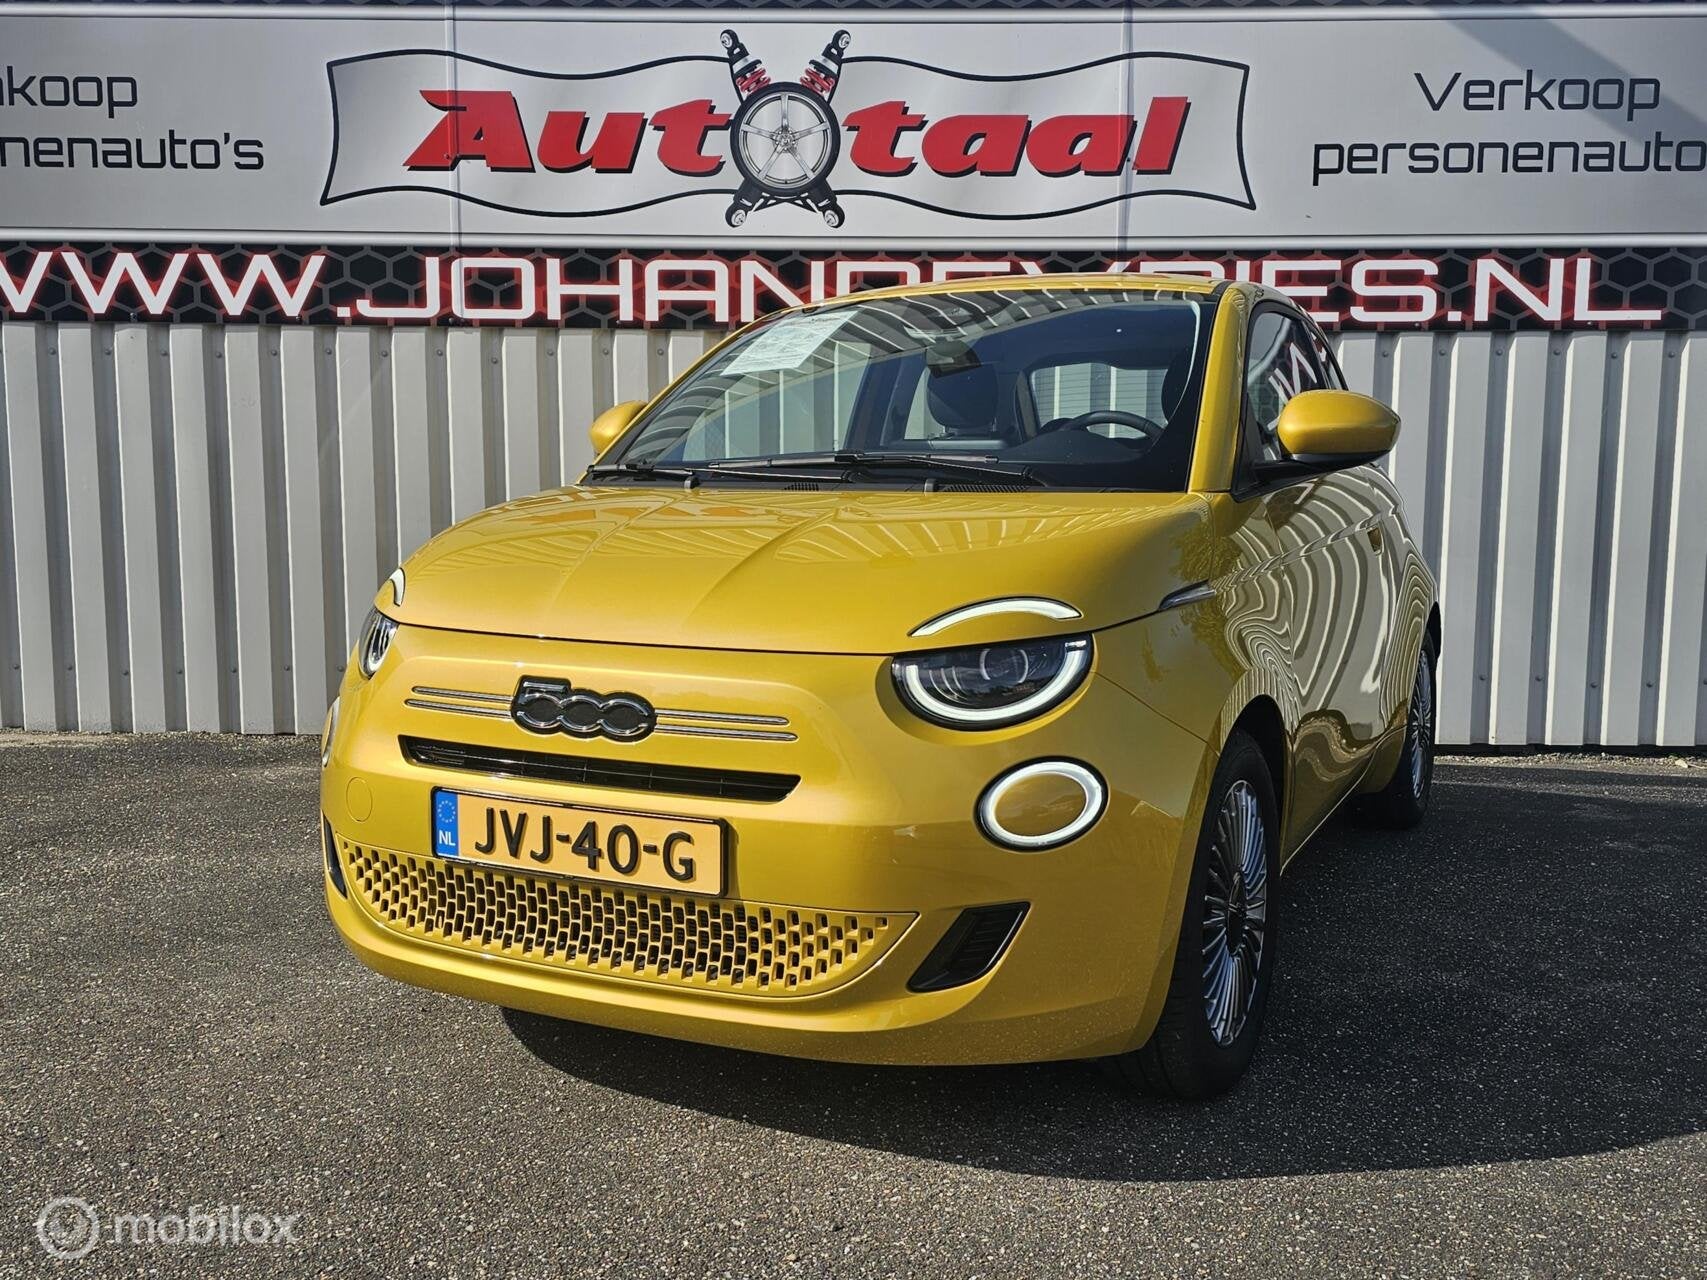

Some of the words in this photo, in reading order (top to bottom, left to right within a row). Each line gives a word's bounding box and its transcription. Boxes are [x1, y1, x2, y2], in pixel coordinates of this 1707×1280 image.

[0, 66, 138, 118] koop
[1414, 70, 1661, 121] Verkoop
[0, 130, 264, 170] nenauto's
[1313, 131, 1707, 186] personenauto
[511, 675, 657, 743] 500
[438, 829, 456, 847] NL
[474, 807, 695, 881] JVJ-40-G
